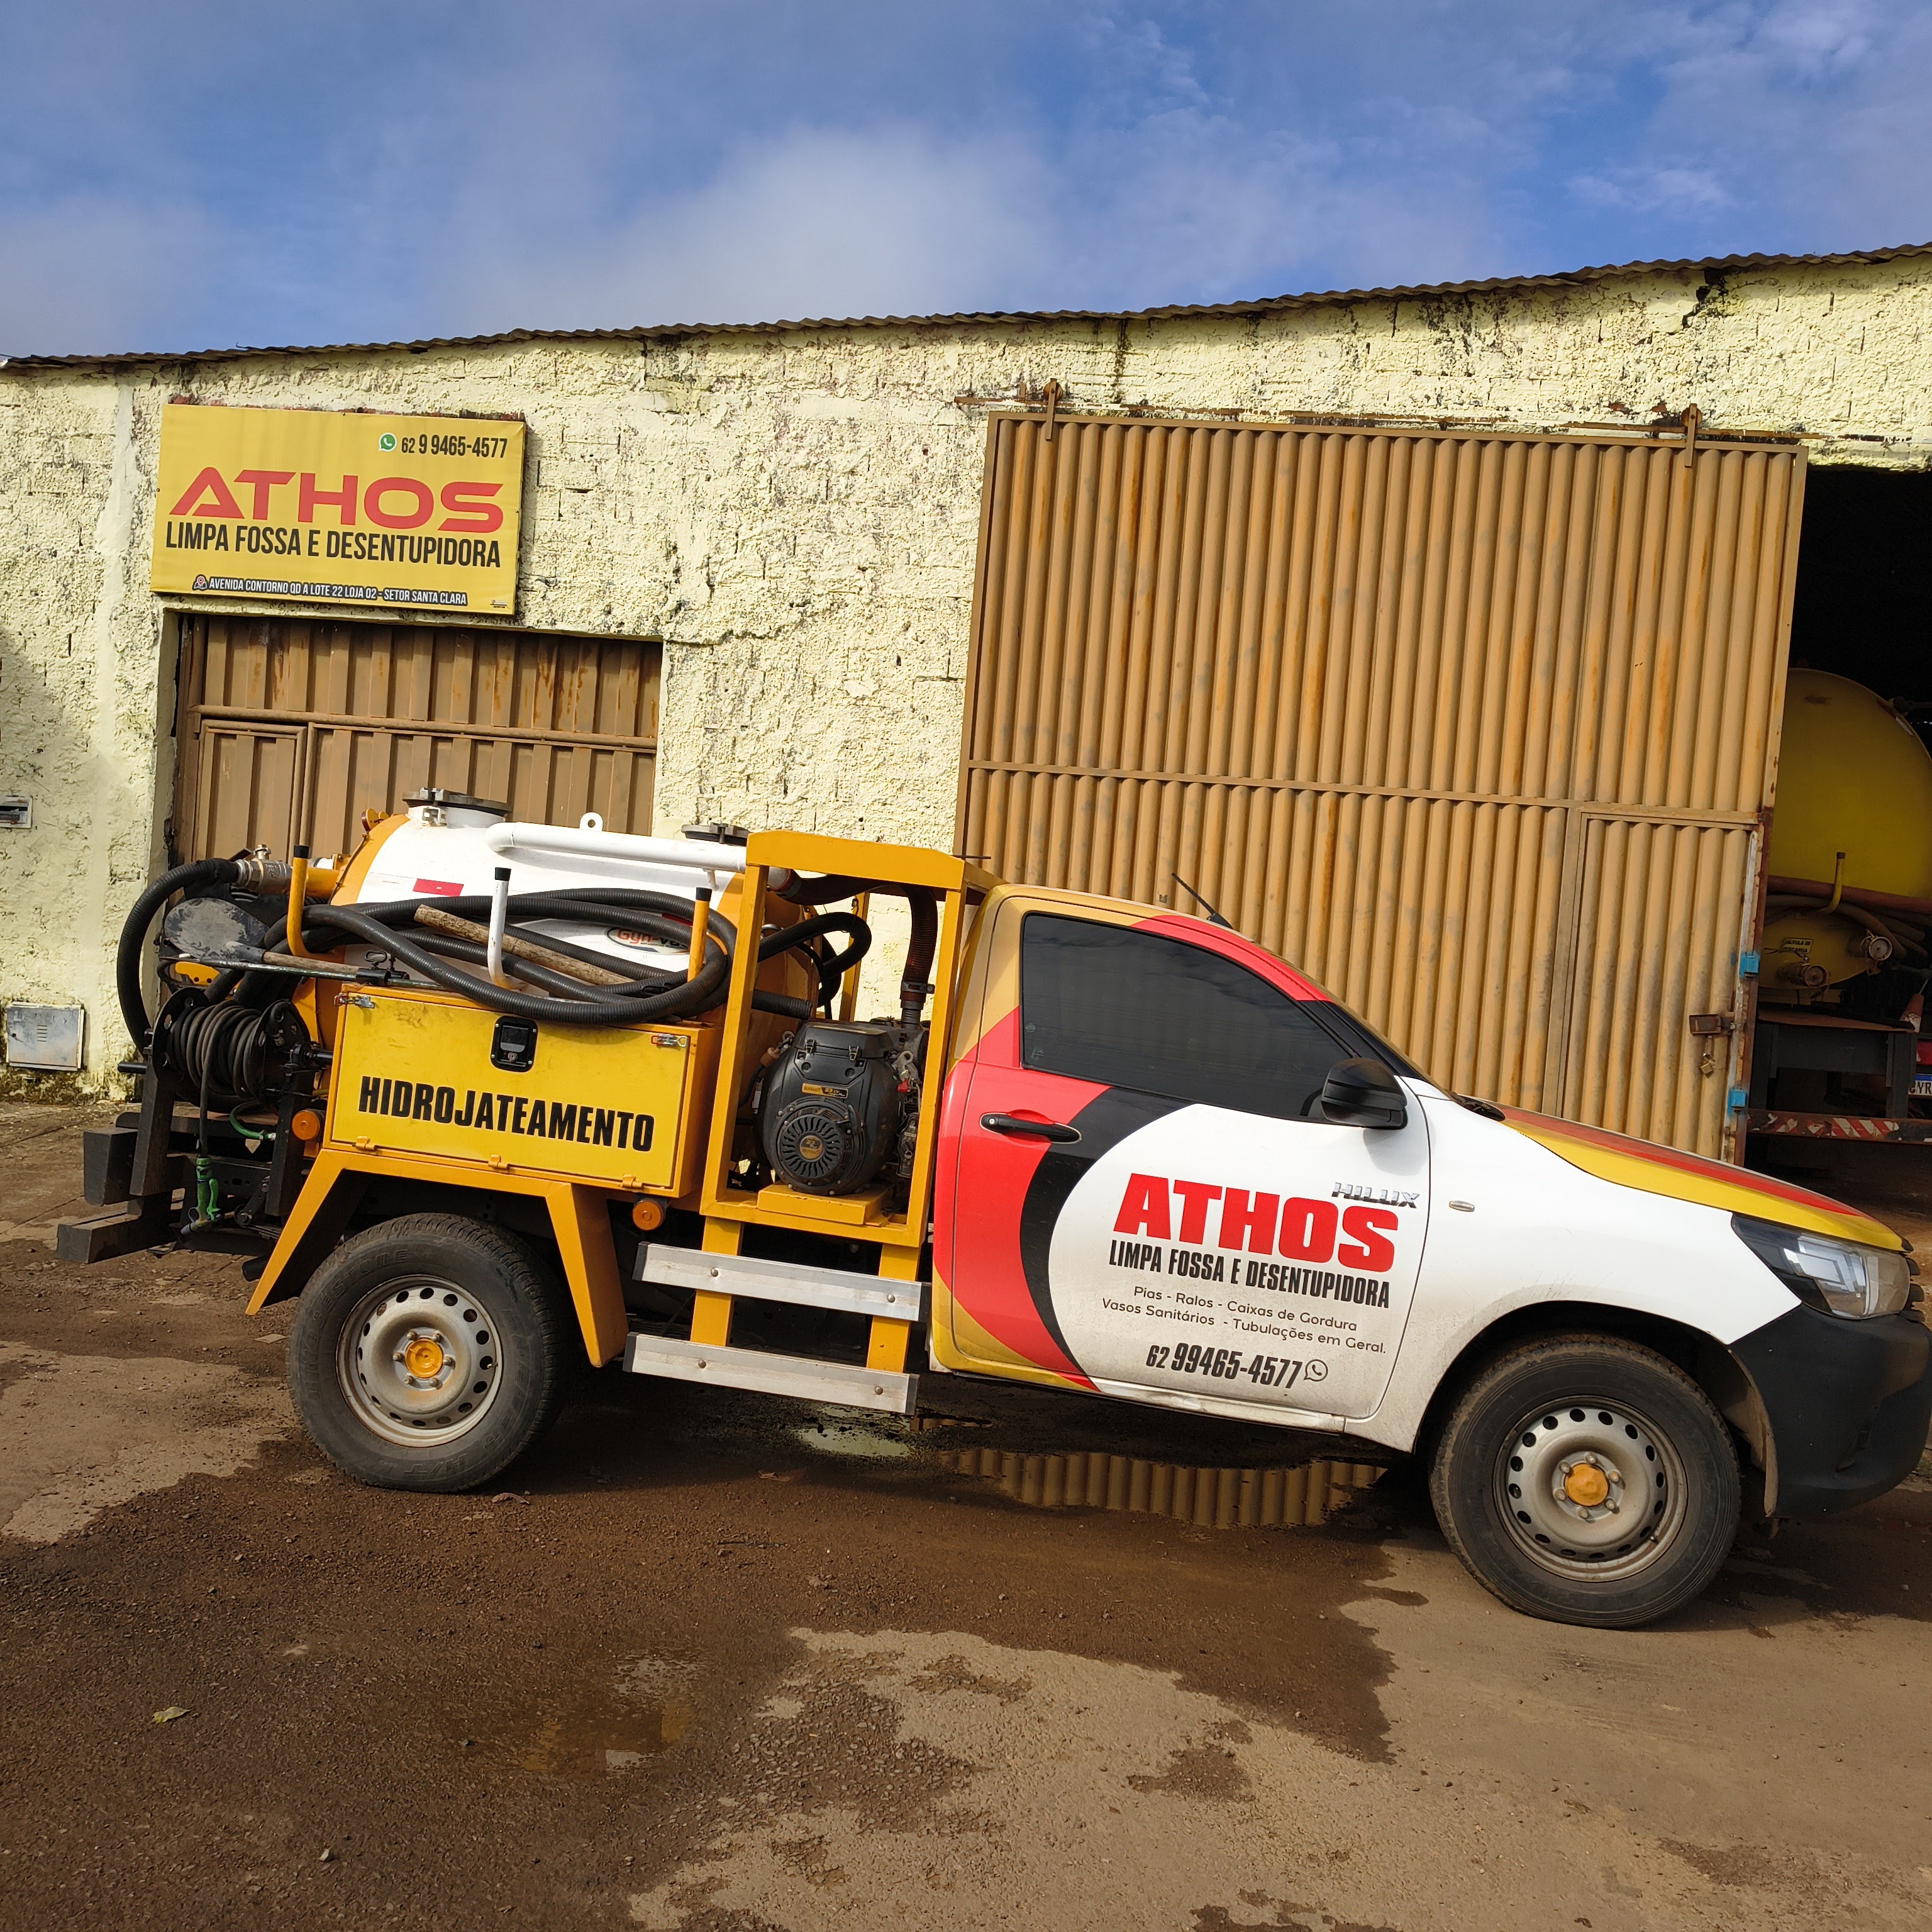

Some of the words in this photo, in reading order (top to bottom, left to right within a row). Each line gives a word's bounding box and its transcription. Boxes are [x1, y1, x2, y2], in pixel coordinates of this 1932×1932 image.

[401, 436, 416, 454] 62
[418, 433, 428, 454] 9
[430, 434, 508, 458] 9465-4577
[169, 467, 504, 533] ATHOS
[165, 521, 229, 552] LIMPA
[235, 525, 301, 556] FOSSA
[308, 530, 319, 557] E
[326, 532, 501, 567] DESENTUPIDORA
[209, 577, 244, 591] AVENIDA
[245, 580, 289, 593] CONTORNO
[290, 582, 301, 594] QD
[303, 584, 308, 594] A
[310, 584, 330, 596] LOTE
[332, 586, 343, 597] 22
[345, 586, 364, 599] LOJA
[384, 589, 410, 601] SETOR
[412, 590, 438, 603] SANTA
[440, 592, 467, 605] CLARA
[358, 1075, 655, 1152] HIDROJATEAMENTO
[1331, 1182, 1420, 1209] HILUX
[1113, 1172, 1399, 1273] ATHOS
[1109, 1240, 1162, 1273] LIMPA
[1168, 1248, 1224, 1283] FOSSA
[1230, 1258, 1241, 1285] E
[1245, 1260, 1390, 1309] DESENTUPIDORA
[1102, 1297, 1141, 1314] Vasos
[1145, 1305, 1215, 1325] Sanitários
[1233, 1318, 1314, 1341] Tubulações
[1318, 1335, 1341, 1346] em
[1345, 1337, 1386, 1353] Geral.
[1134, 1286, 1162, 1300] Pias
[1175, 1292, 1214, 1308] Ralos
[1227, 1301, 1274, 1317] Caixas
[1277, 1309, 1296, 1321] de
[1300, 1312, 1358, 1331] Gordura
[1146, 1345, 1170, 1368] 62
[1170, 1343, 1303, 1389] 99465-4577
